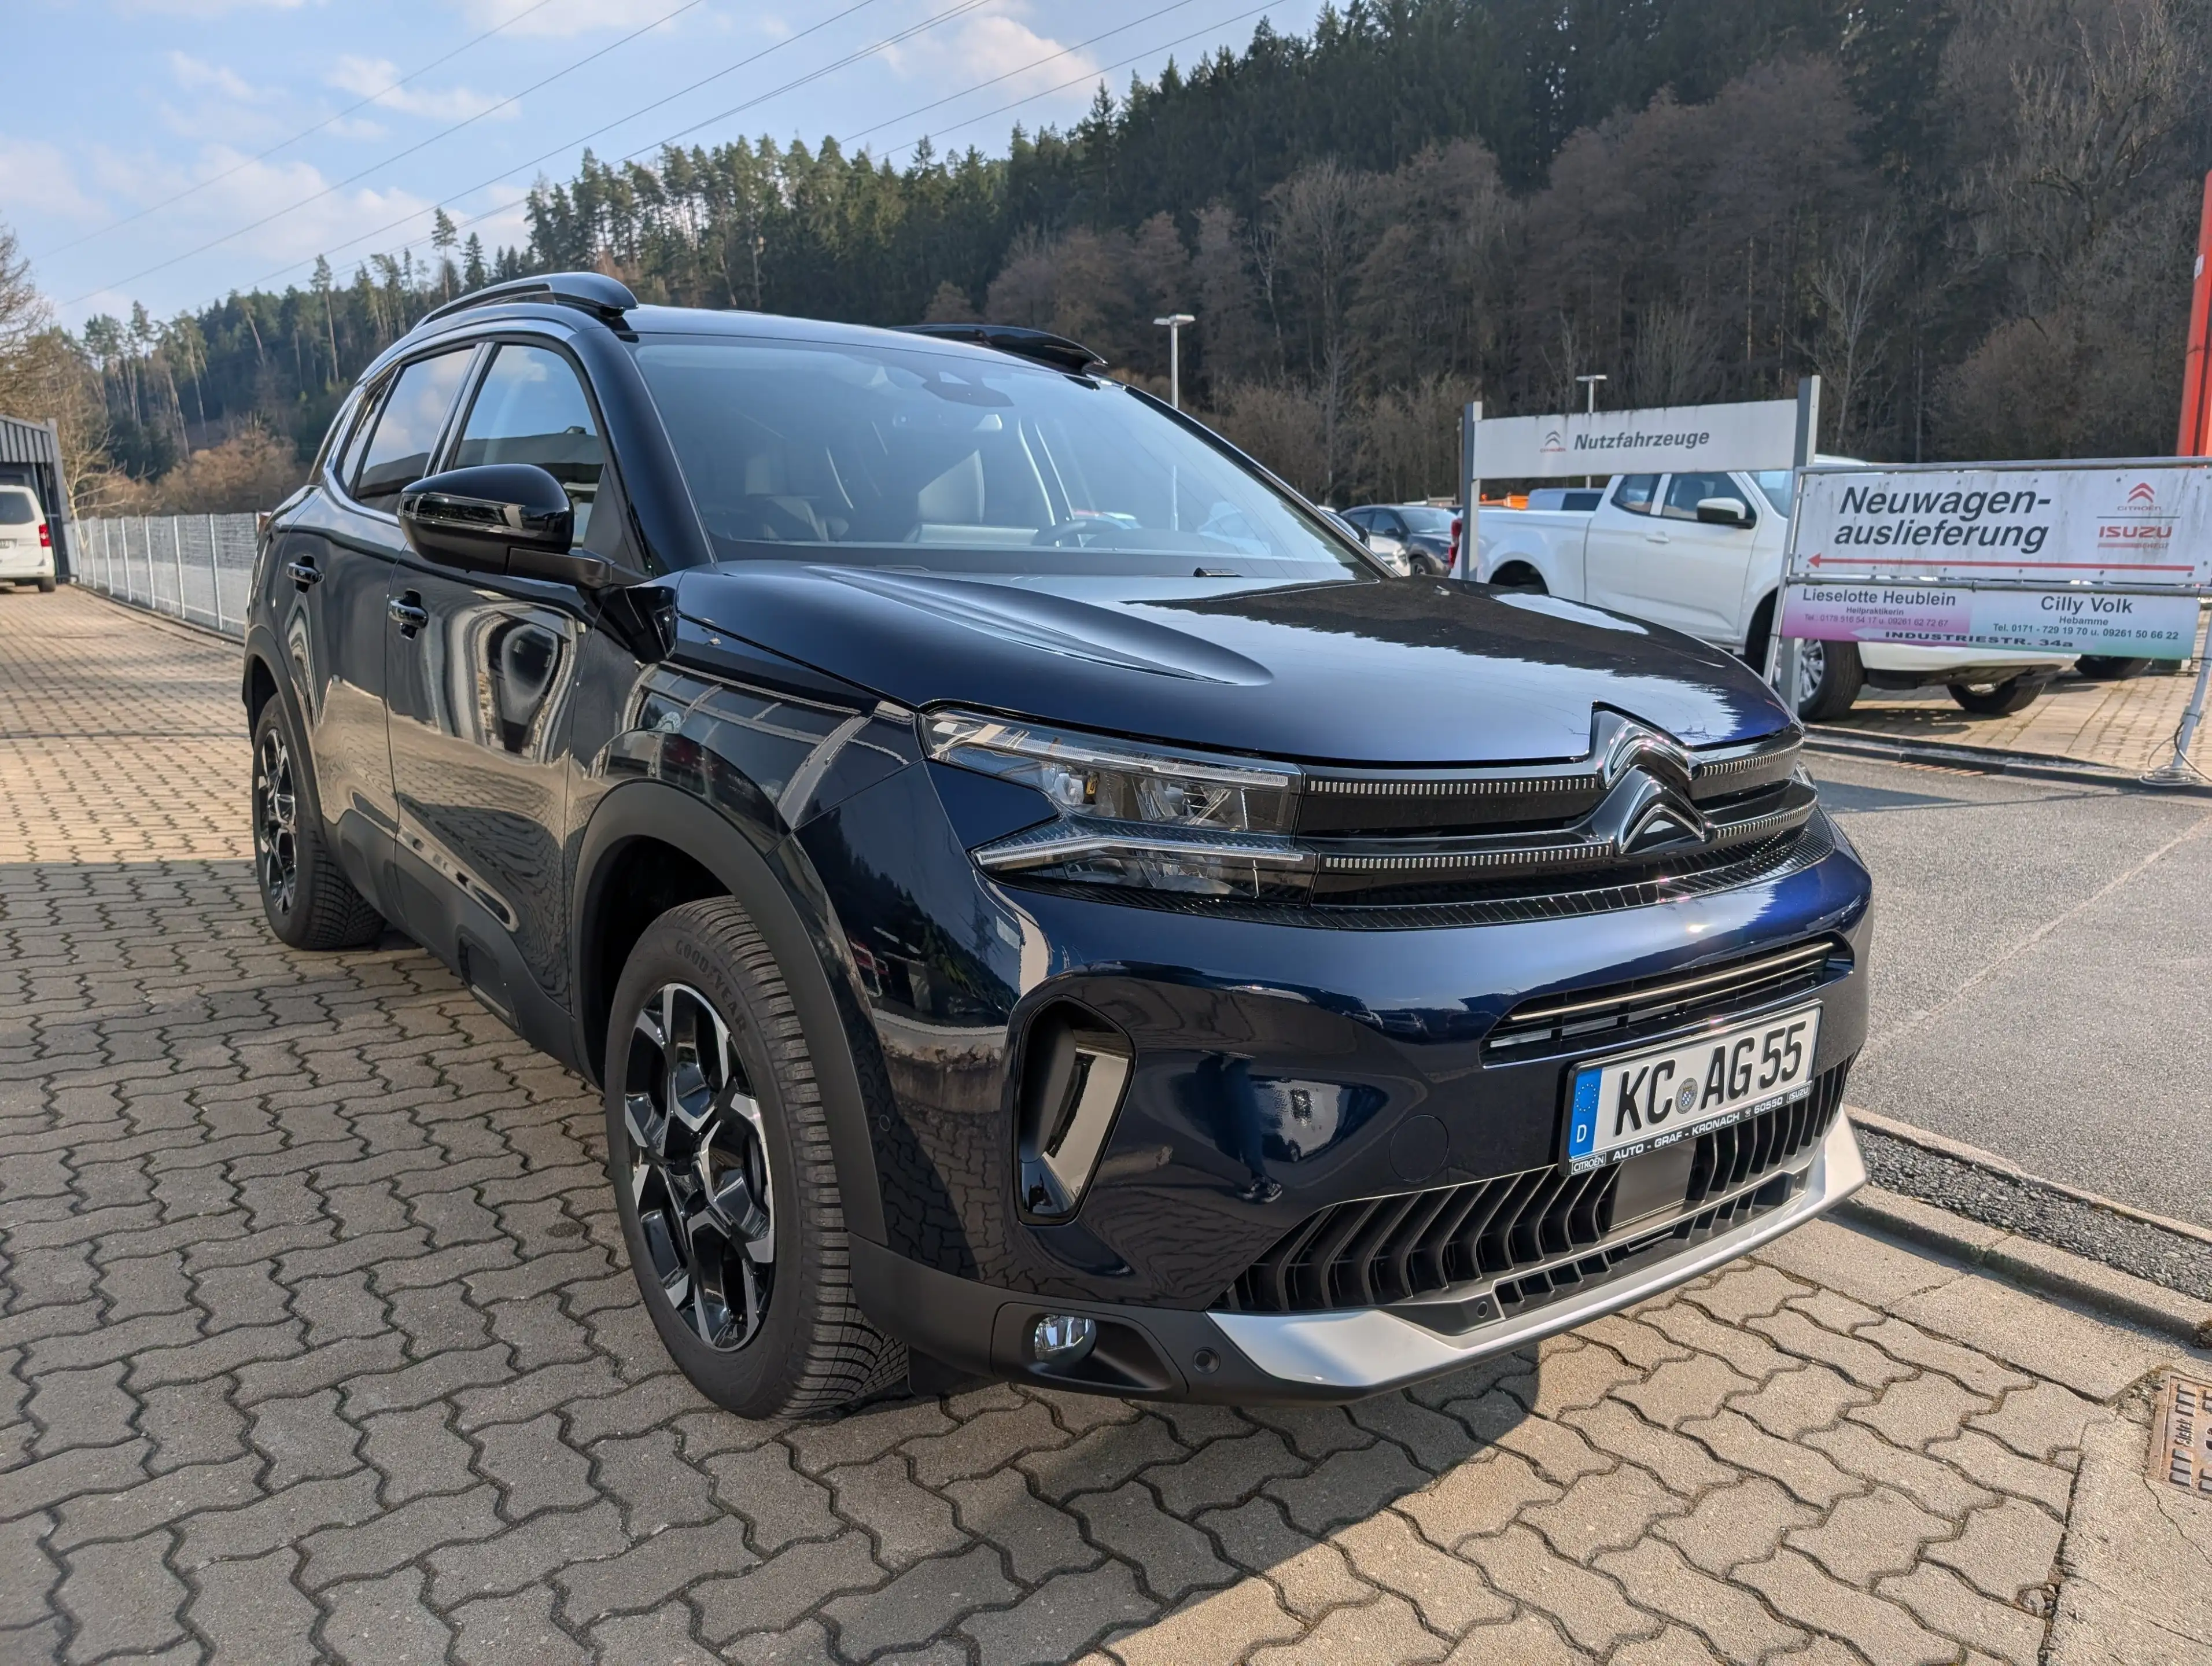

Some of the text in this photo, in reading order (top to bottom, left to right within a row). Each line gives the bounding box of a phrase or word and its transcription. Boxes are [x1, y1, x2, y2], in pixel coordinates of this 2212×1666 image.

[1574, 431, 1709, 450] Nutzfahrzeuge
[1839, 486, 2052, 522] Neuwagen-
[1834, 519, 2049, 554] auslieferung
[2099, 525, 2172, 538] ISUZU
[1802, 588, 1956, 606] Lieselotte Heublein
[2041, 596, 2133, 615] Cilly Volk
[1846, 606, 1904, 615] Heilpraktikerin
[1888, 618, 1911, 626] 09261
[1926, 619, 1936, 627] 72
[2059, 615, 2108, 625] Hebamme
[1885, 631, 2073, 647] INDUSTRIESTR. 34a
[1993, 623, 2008, 632] Tel.
[2011, 624, 2033, 633] 0171
[2043, 625, 2059, 634] 729
[2063, 626, 2073, 635] 19
[2077, 627, 2088, 635] 70
[2103, 628, 2132, 637] 09261
[2136, 630, 2148, 639] 50
[2151, 631, 2163, 639] 66
[2166, 631, 2178, 640] 22
[1613, 1059, 1676, 1137] KC
[1698, 1035, 1756, 1111] AG
[1758, 1020, 1807, 1090] 55
[1789, 1086, 1809, 1102] ISUZU
[1576, 1124, 1587, 1143] D
[1612, 1143, 1643, 1162] AUTO
[1654, 1131, 1683, 1149] GRAF
[1692, 1112, 1740, 1136] KRONACH
[1754, 1096, 1783, 1115] 60550
[1573, 1155, 1605, 1173] CITROËN
